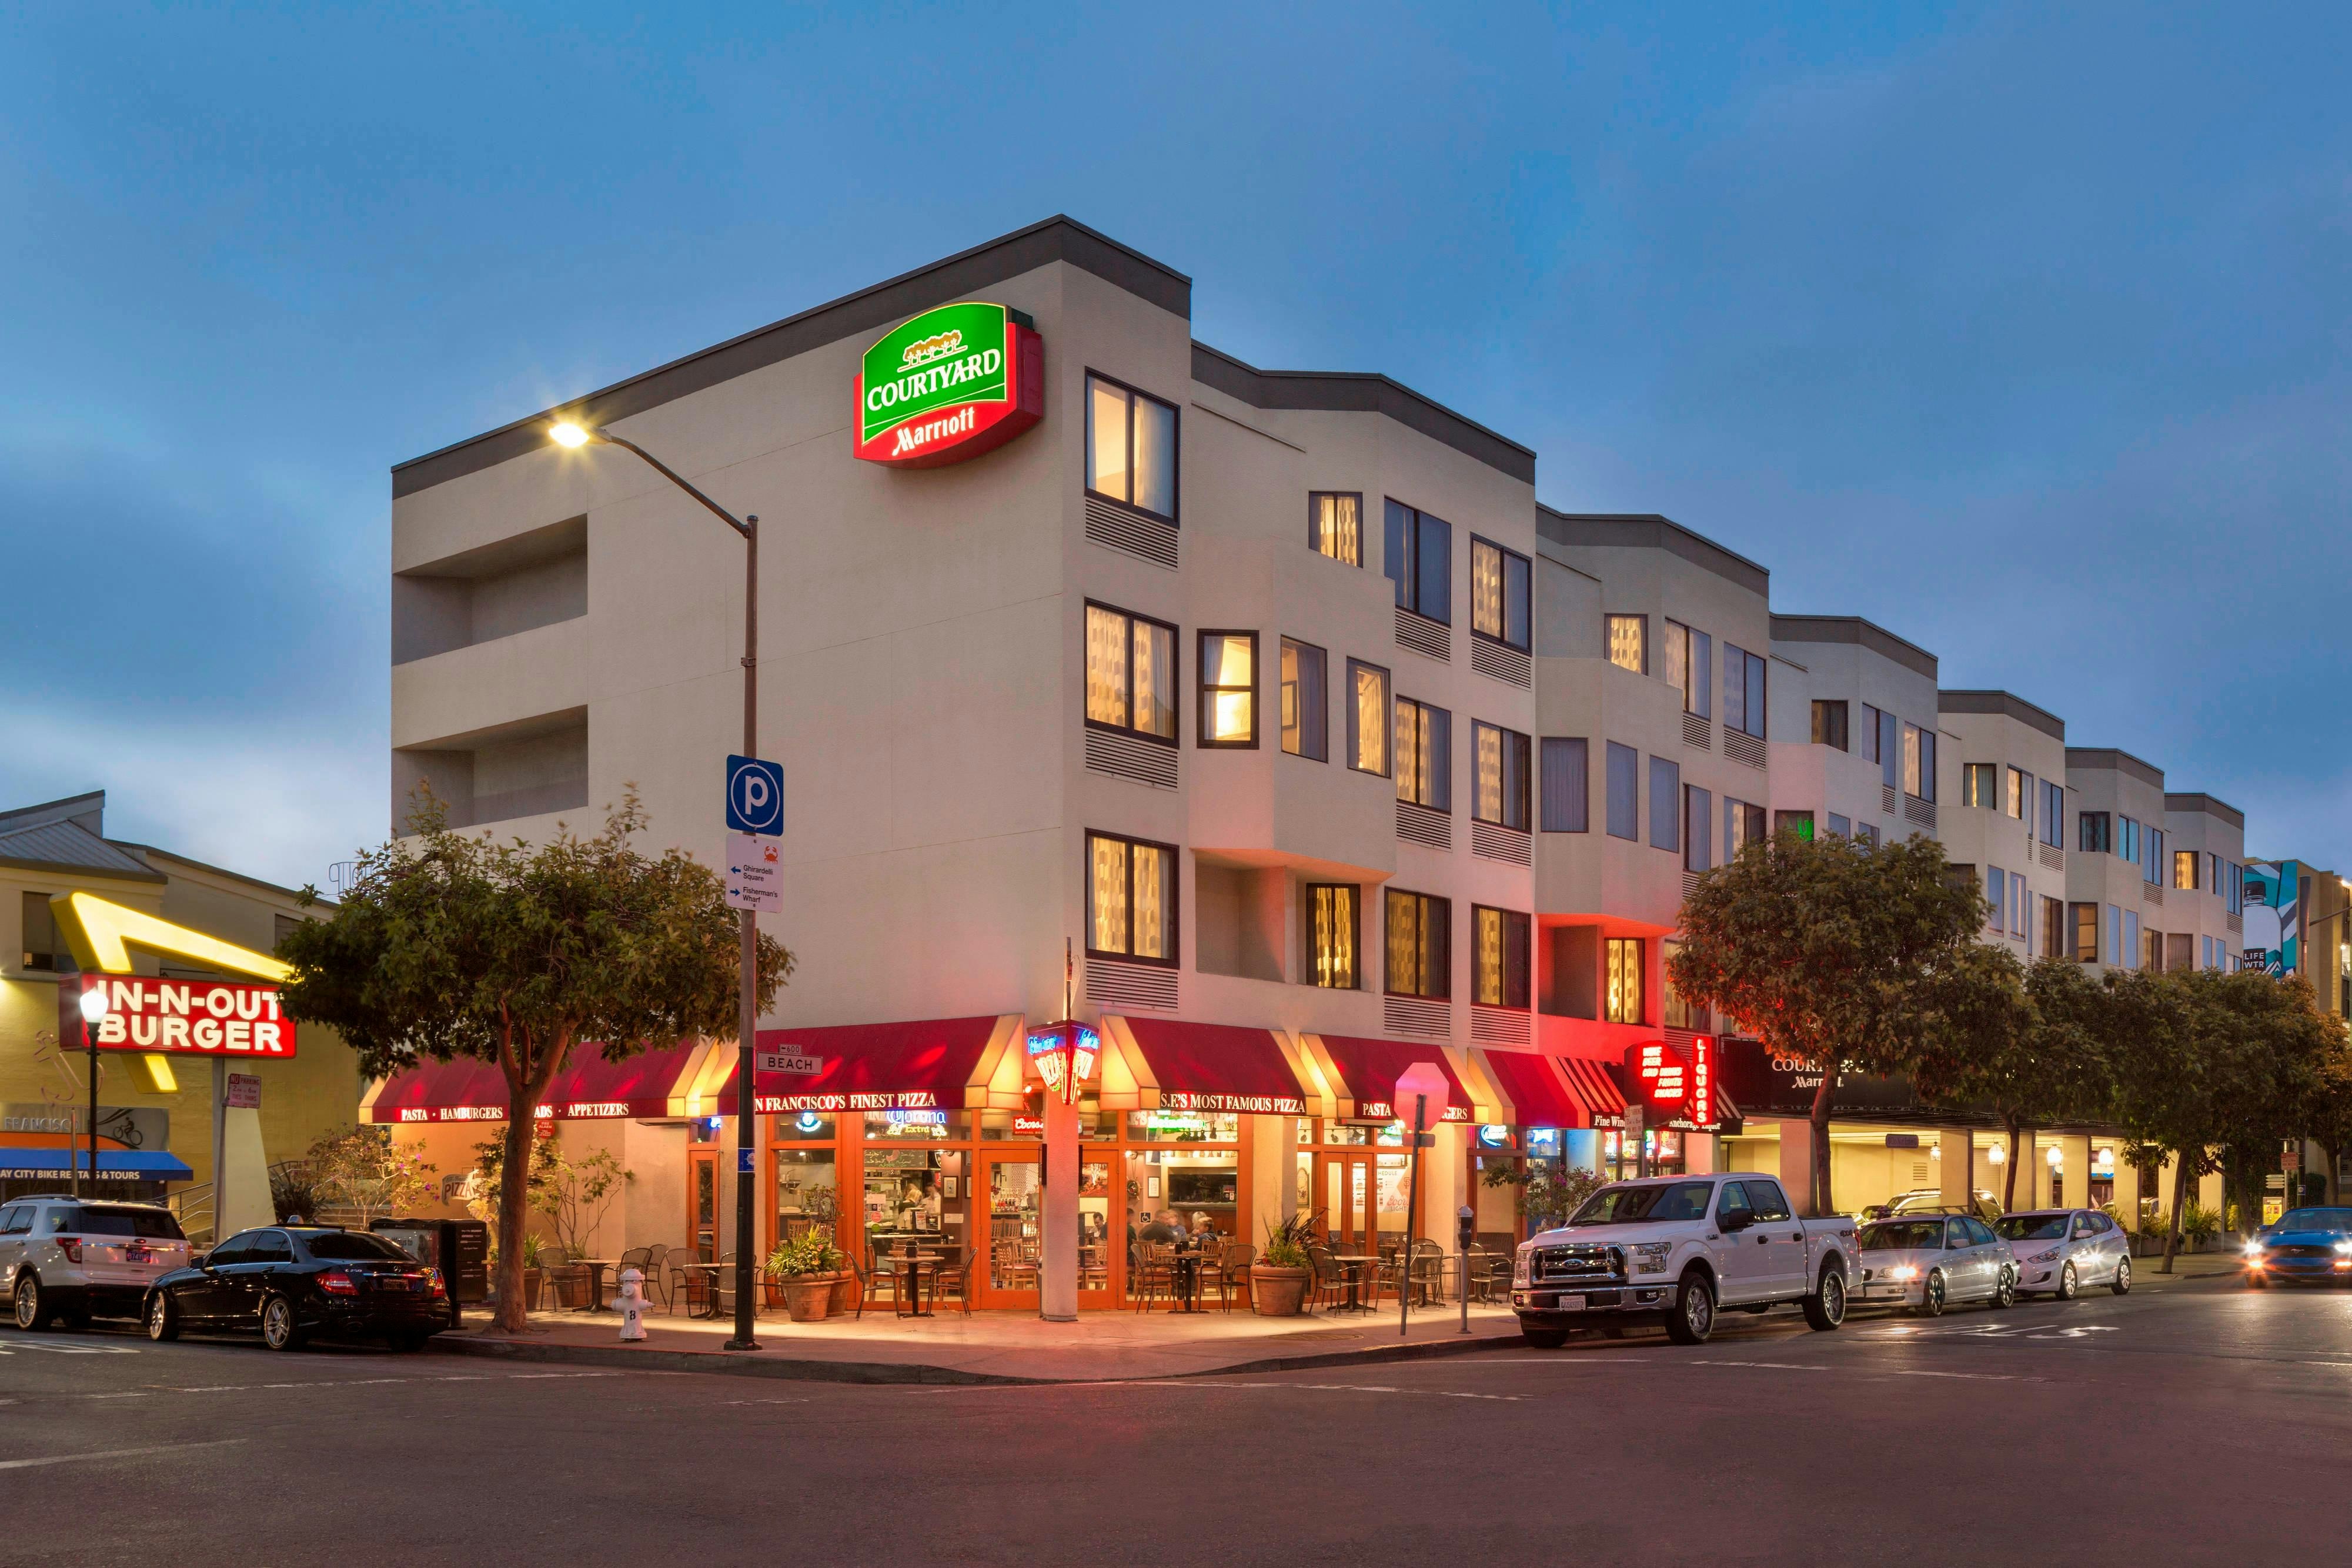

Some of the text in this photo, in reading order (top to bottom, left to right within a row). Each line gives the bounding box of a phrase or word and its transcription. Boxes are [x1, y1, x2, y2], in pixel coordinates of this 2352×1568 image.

[866, 349, 1001, 412] COURTYARD
[891, 406, 975, 457] Marriott
[743, 864, 774, 875] Ghirardelli
[743, 872, 764, 882] Square
[743, 886, 779, 898] Fisherman's
[743, 894, 761, 903] Wharf
[2244, 961, 2264, 969] WTR
[97, 1014, 282, 1052] BURGER
[768, 1057, 812, 1070] BEACH
[230, 1074, 239, 1084] NO
[1696, 1039, 1708, 1123] LIQUORS
[766, 1095, 845, 1111] FRANCISCO'S
[850, 1094, 894, 1109] FINEST
[897, 1092, 936, 1107] PIZZA
[1190, 1094, 1224, 1109] MOST
[1226, 1095, 1272, 1112] FAMOUS
[1274, 1098, 1305, 1113] PIZZA
[402, 1109, 427, 1121] PASTA
[440, 1107, 503, 1120] HAMBURGERS
[567, 1103, 629, 1116] APPETIZERS
[1362, 1103, 1391, 1116] PASTA
[886, 1110, 946, 1125] Corona
[1594, 1115, 1611, 1126] Fine
[905, 1124, 930, 1133] Extra
[14, 1169, 35, 1178] CITY
[37, 1170, 58, 1178] BIKE
[110, 1171, 140, 1179] TOURS
[445, 1182, 472, 1201] PIZZA
